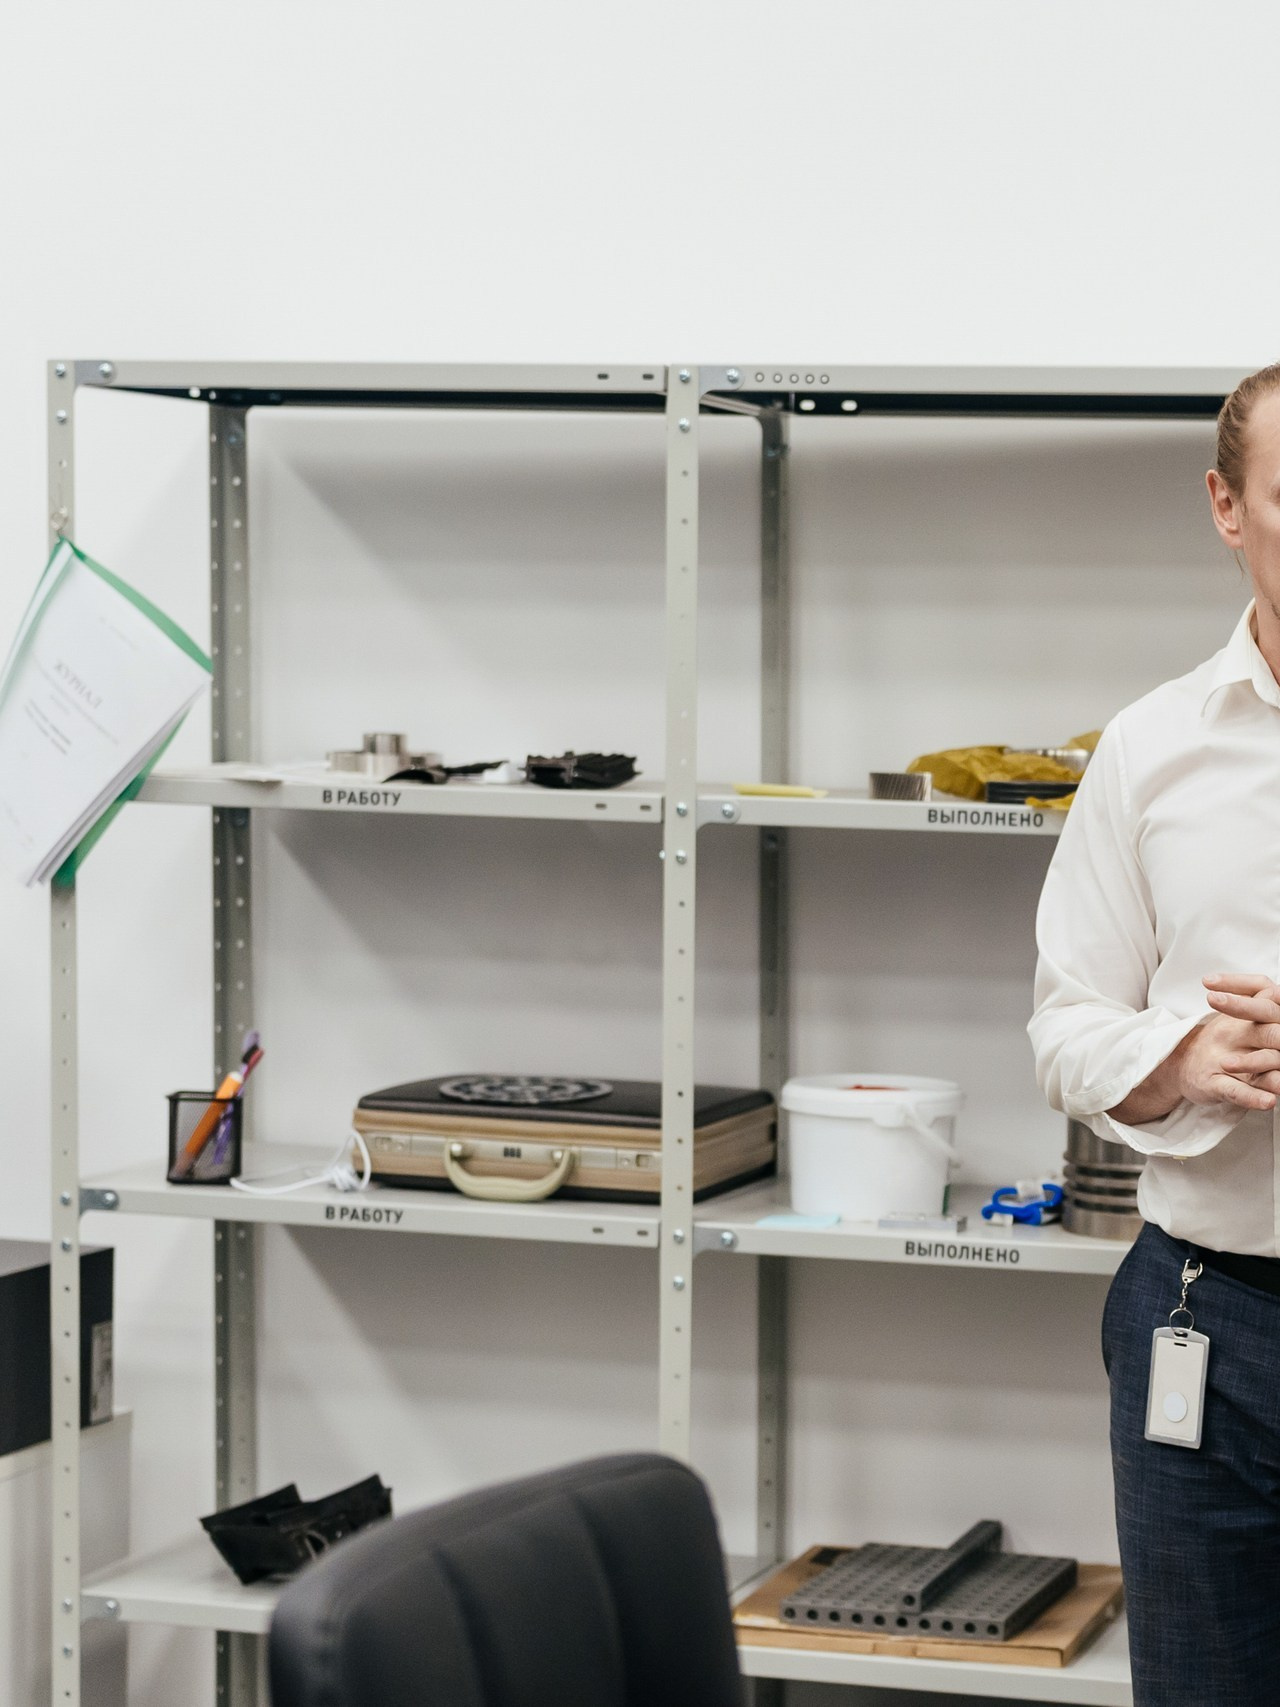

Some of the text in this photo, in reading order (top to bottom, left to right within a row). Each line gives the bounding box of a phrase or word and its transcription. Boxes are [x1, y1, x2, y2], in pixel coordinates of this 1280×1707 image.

[323, 789, 401, 806] В РАБОТУ
[927, 809, 1044, 828] ВЫПОЛНЕНО
[325, 1205, 404, 1224] В РАБОТУ
[905, 1240, 1020, 1264] ВЫПОЛНЕНО
